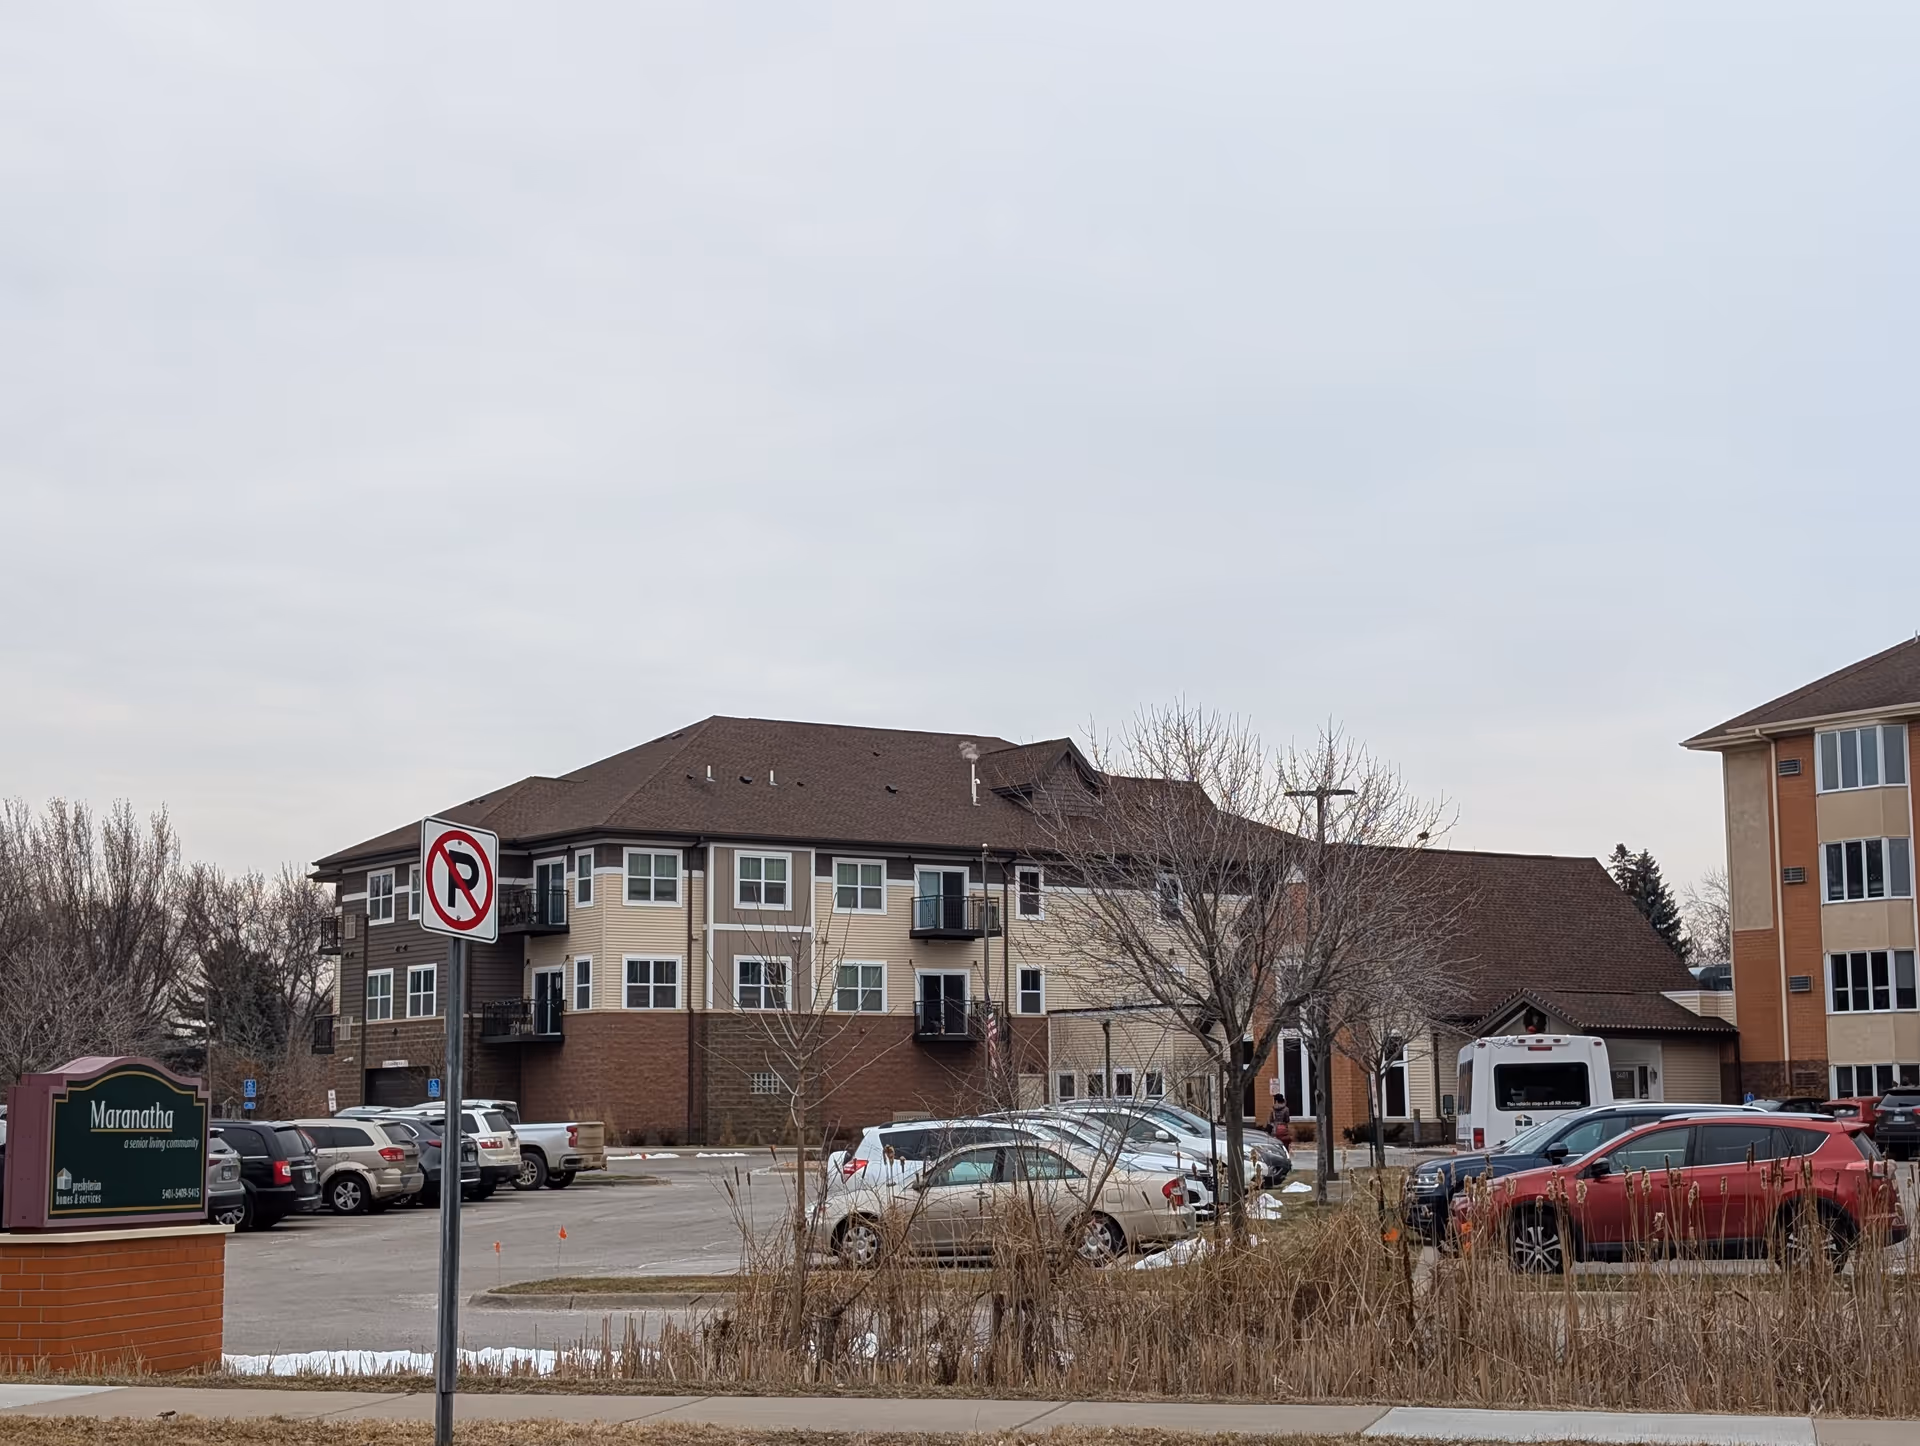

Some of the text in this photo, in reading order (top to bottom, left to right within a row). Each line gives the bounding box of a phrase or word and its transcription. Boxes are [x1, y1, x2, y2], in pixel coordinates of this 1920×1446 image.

[448, 849, 480, 908] P
[90, 1100, 174, 1129] Maranatha
[123, 1136, 199, 1152] a senior living community
[72, 1178, 102, 1194] presbyterian
[56, 1191, 102, 1205] homes & services
